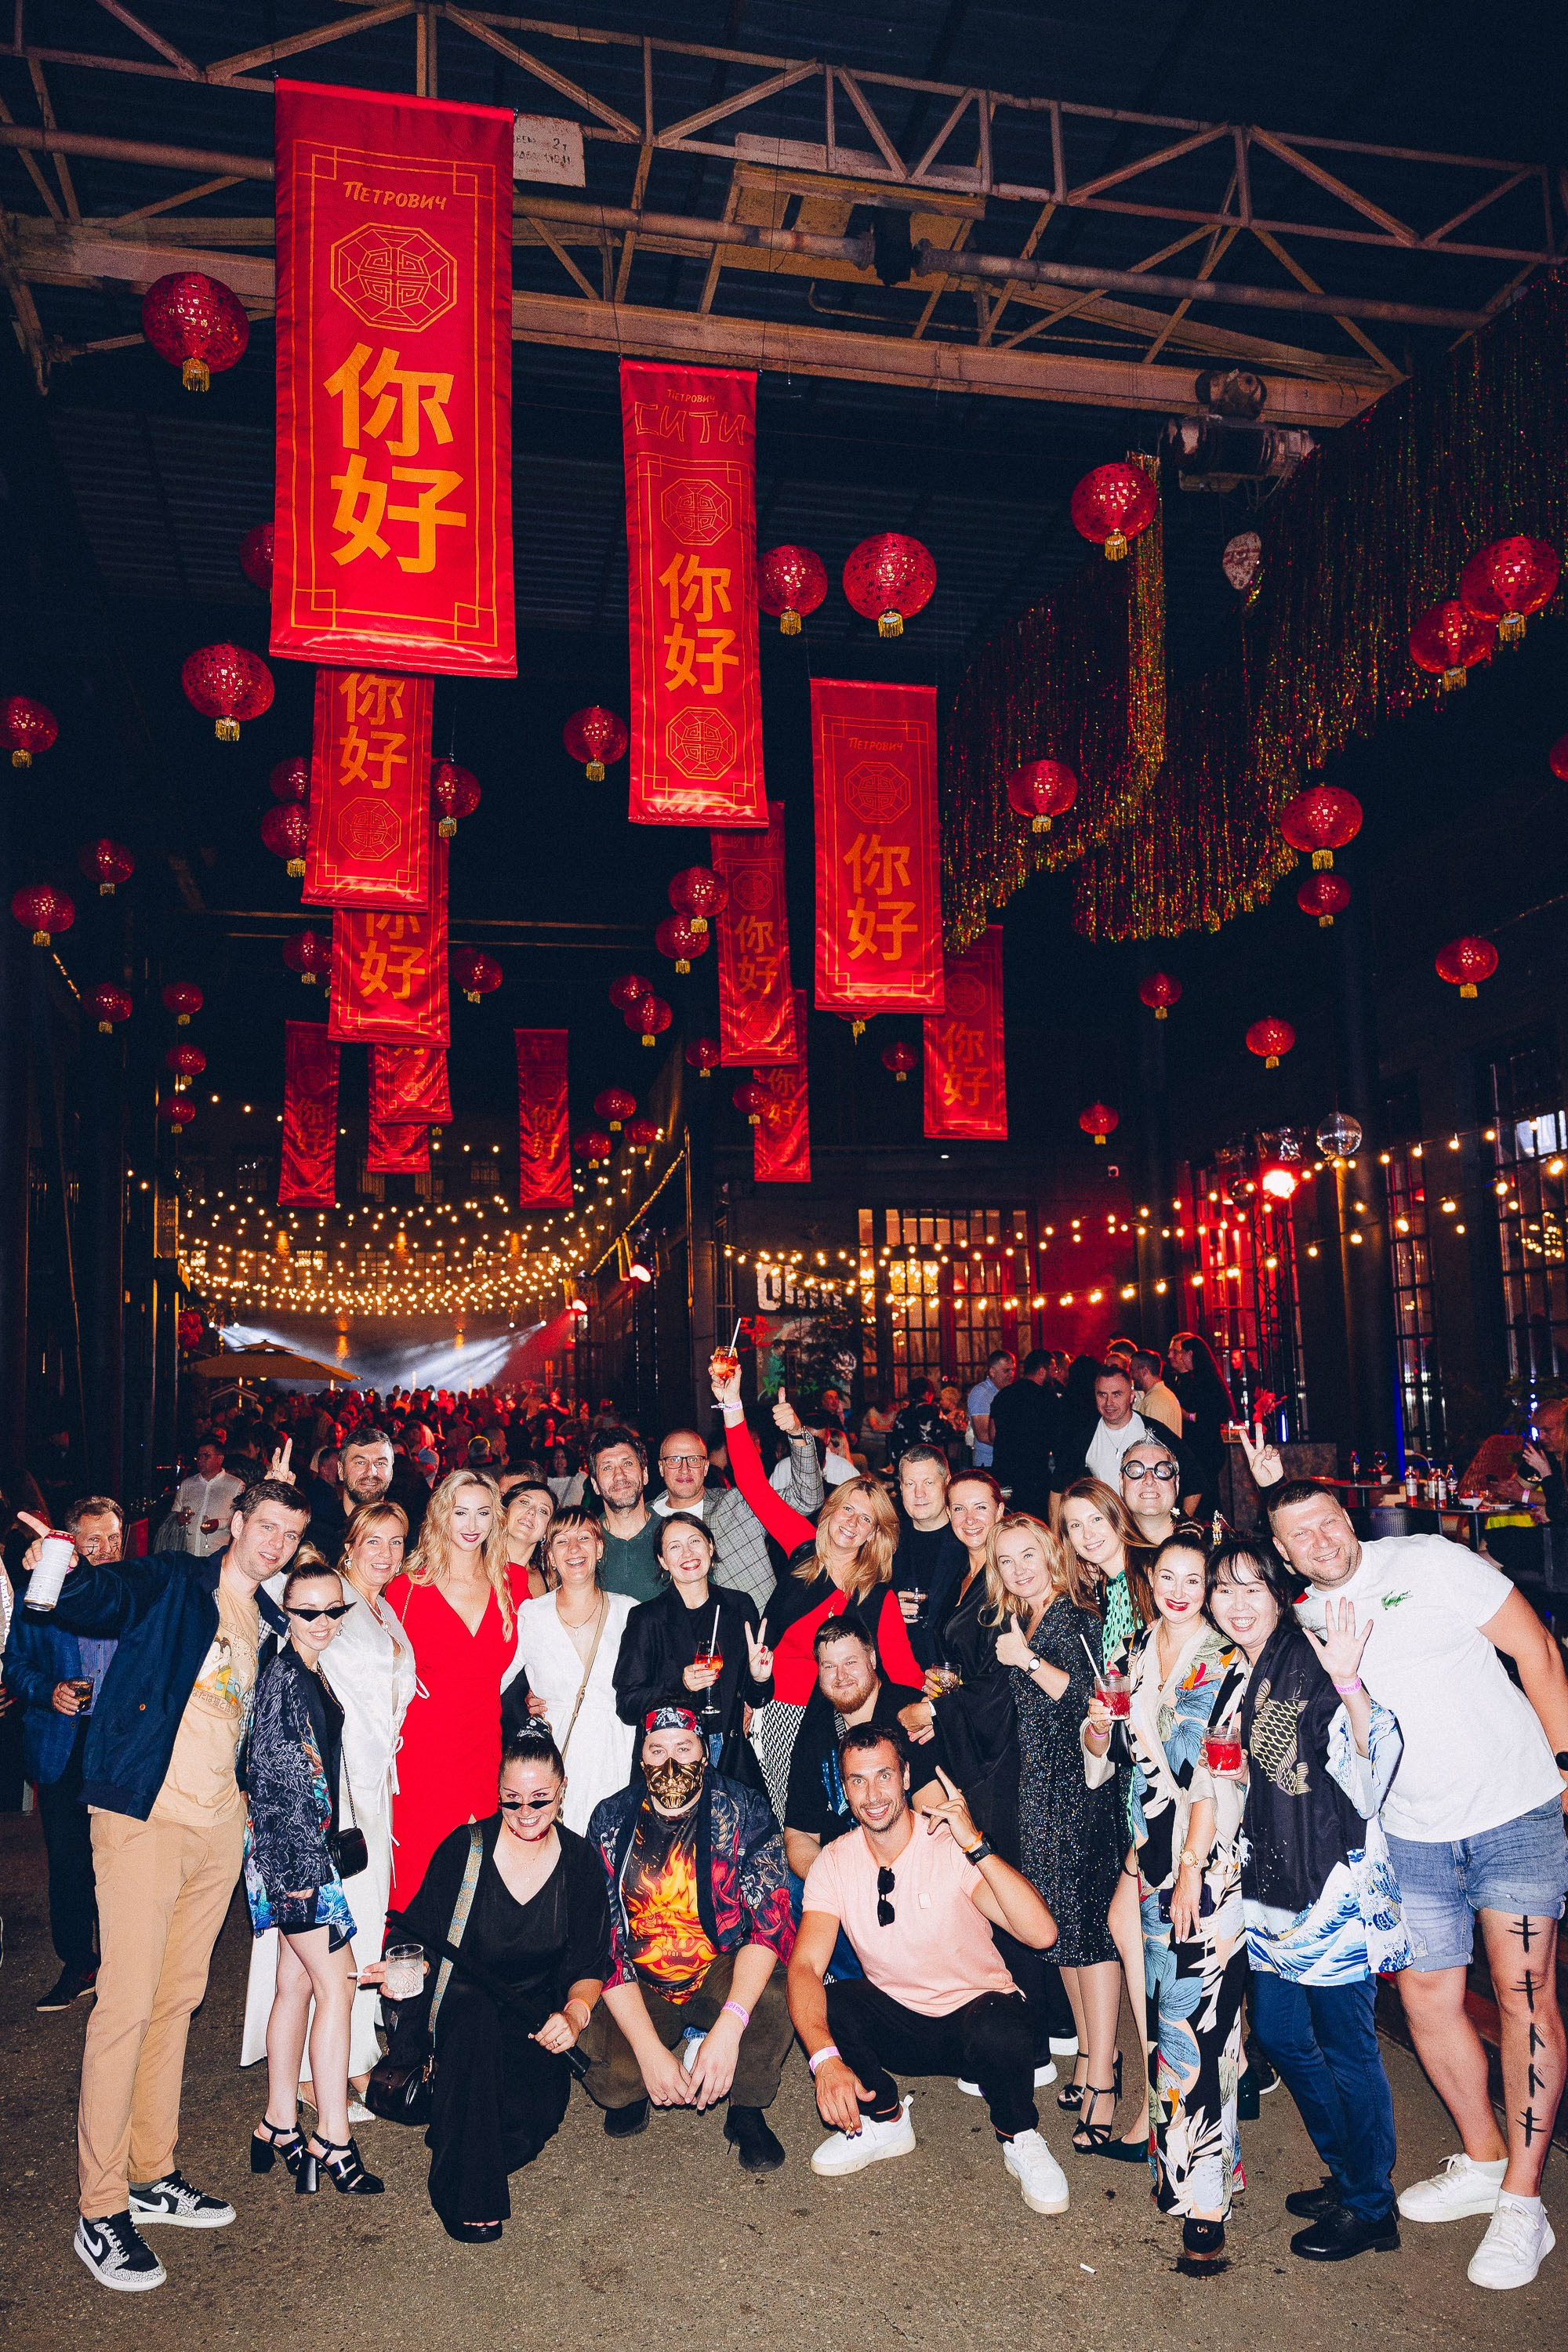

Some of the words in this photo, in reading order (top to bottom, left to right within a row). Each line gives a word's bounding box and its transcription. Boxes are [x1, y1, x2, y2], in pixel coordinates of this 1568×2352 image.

[634, 401, 747, 446] СИТИ
[667, 389, 716, 403] ПЕТРОВИЧ
[324, 342, 466, 574] 你好
[658, 552, 740, 695] 你好
[338, 672, 408, 789] 你好
[848, 737, 904, 751] ПЕТРОВИЧ
[843, 833, 919, 961] 你好
[735, 914, 778, 994] 你好
[942, 1022, 990, 1106] 你好
